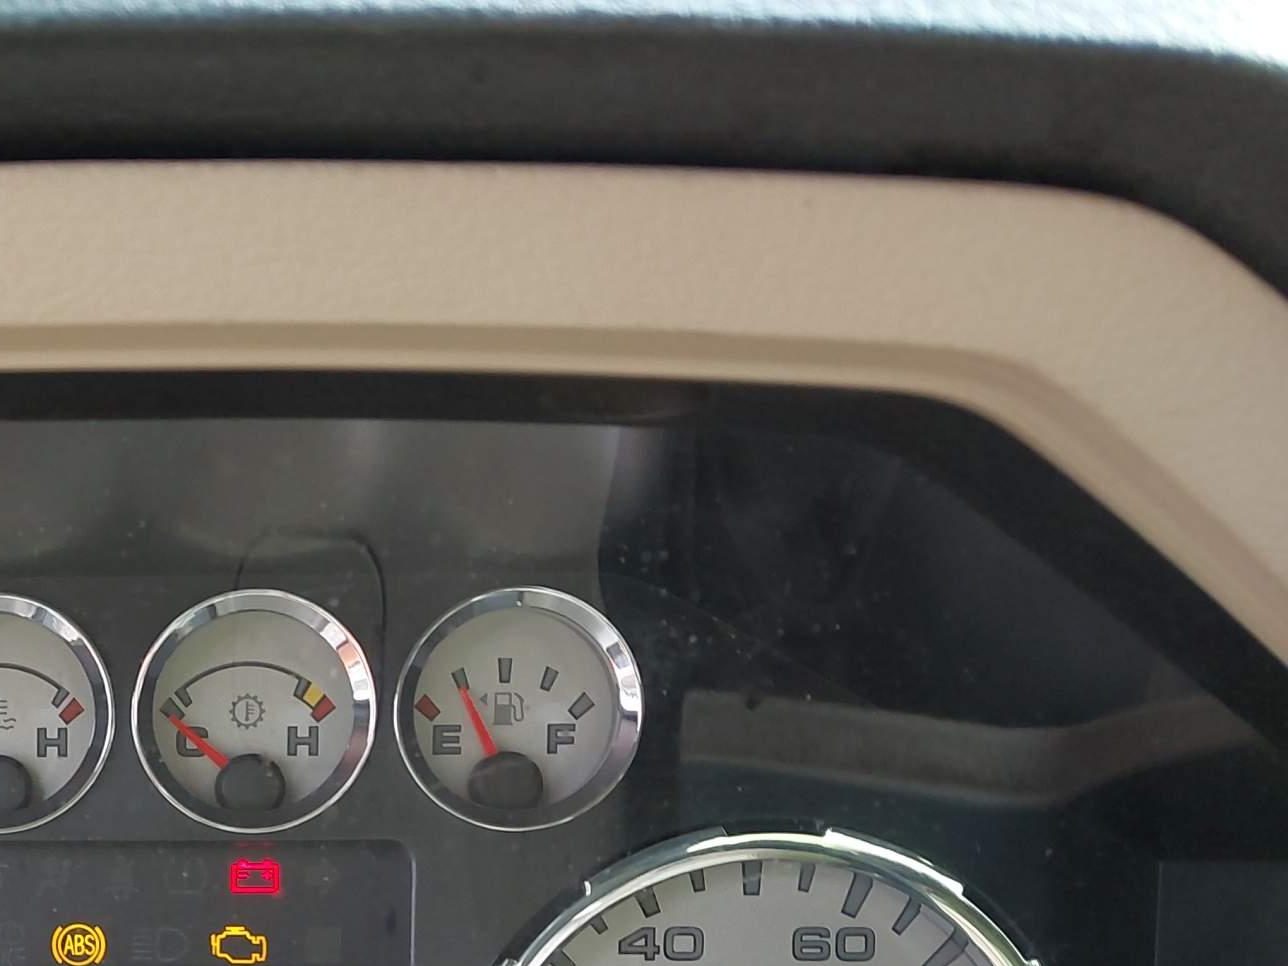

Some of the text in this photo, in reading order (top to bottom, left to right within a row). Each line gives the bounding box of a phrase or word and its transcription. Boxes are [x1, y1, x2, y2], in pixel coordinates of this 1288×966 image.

[37, 727, 68, 758] H
[176, 728, 210, 757] C
[287, 726, 319, 756] H
[432, 725, 462, 756] E
[547, 723, 576, 754] F
[62, 933, 96, 957] ABS
[617, 926, 705, 961] 40
[792, 927, 876, 962] 60
